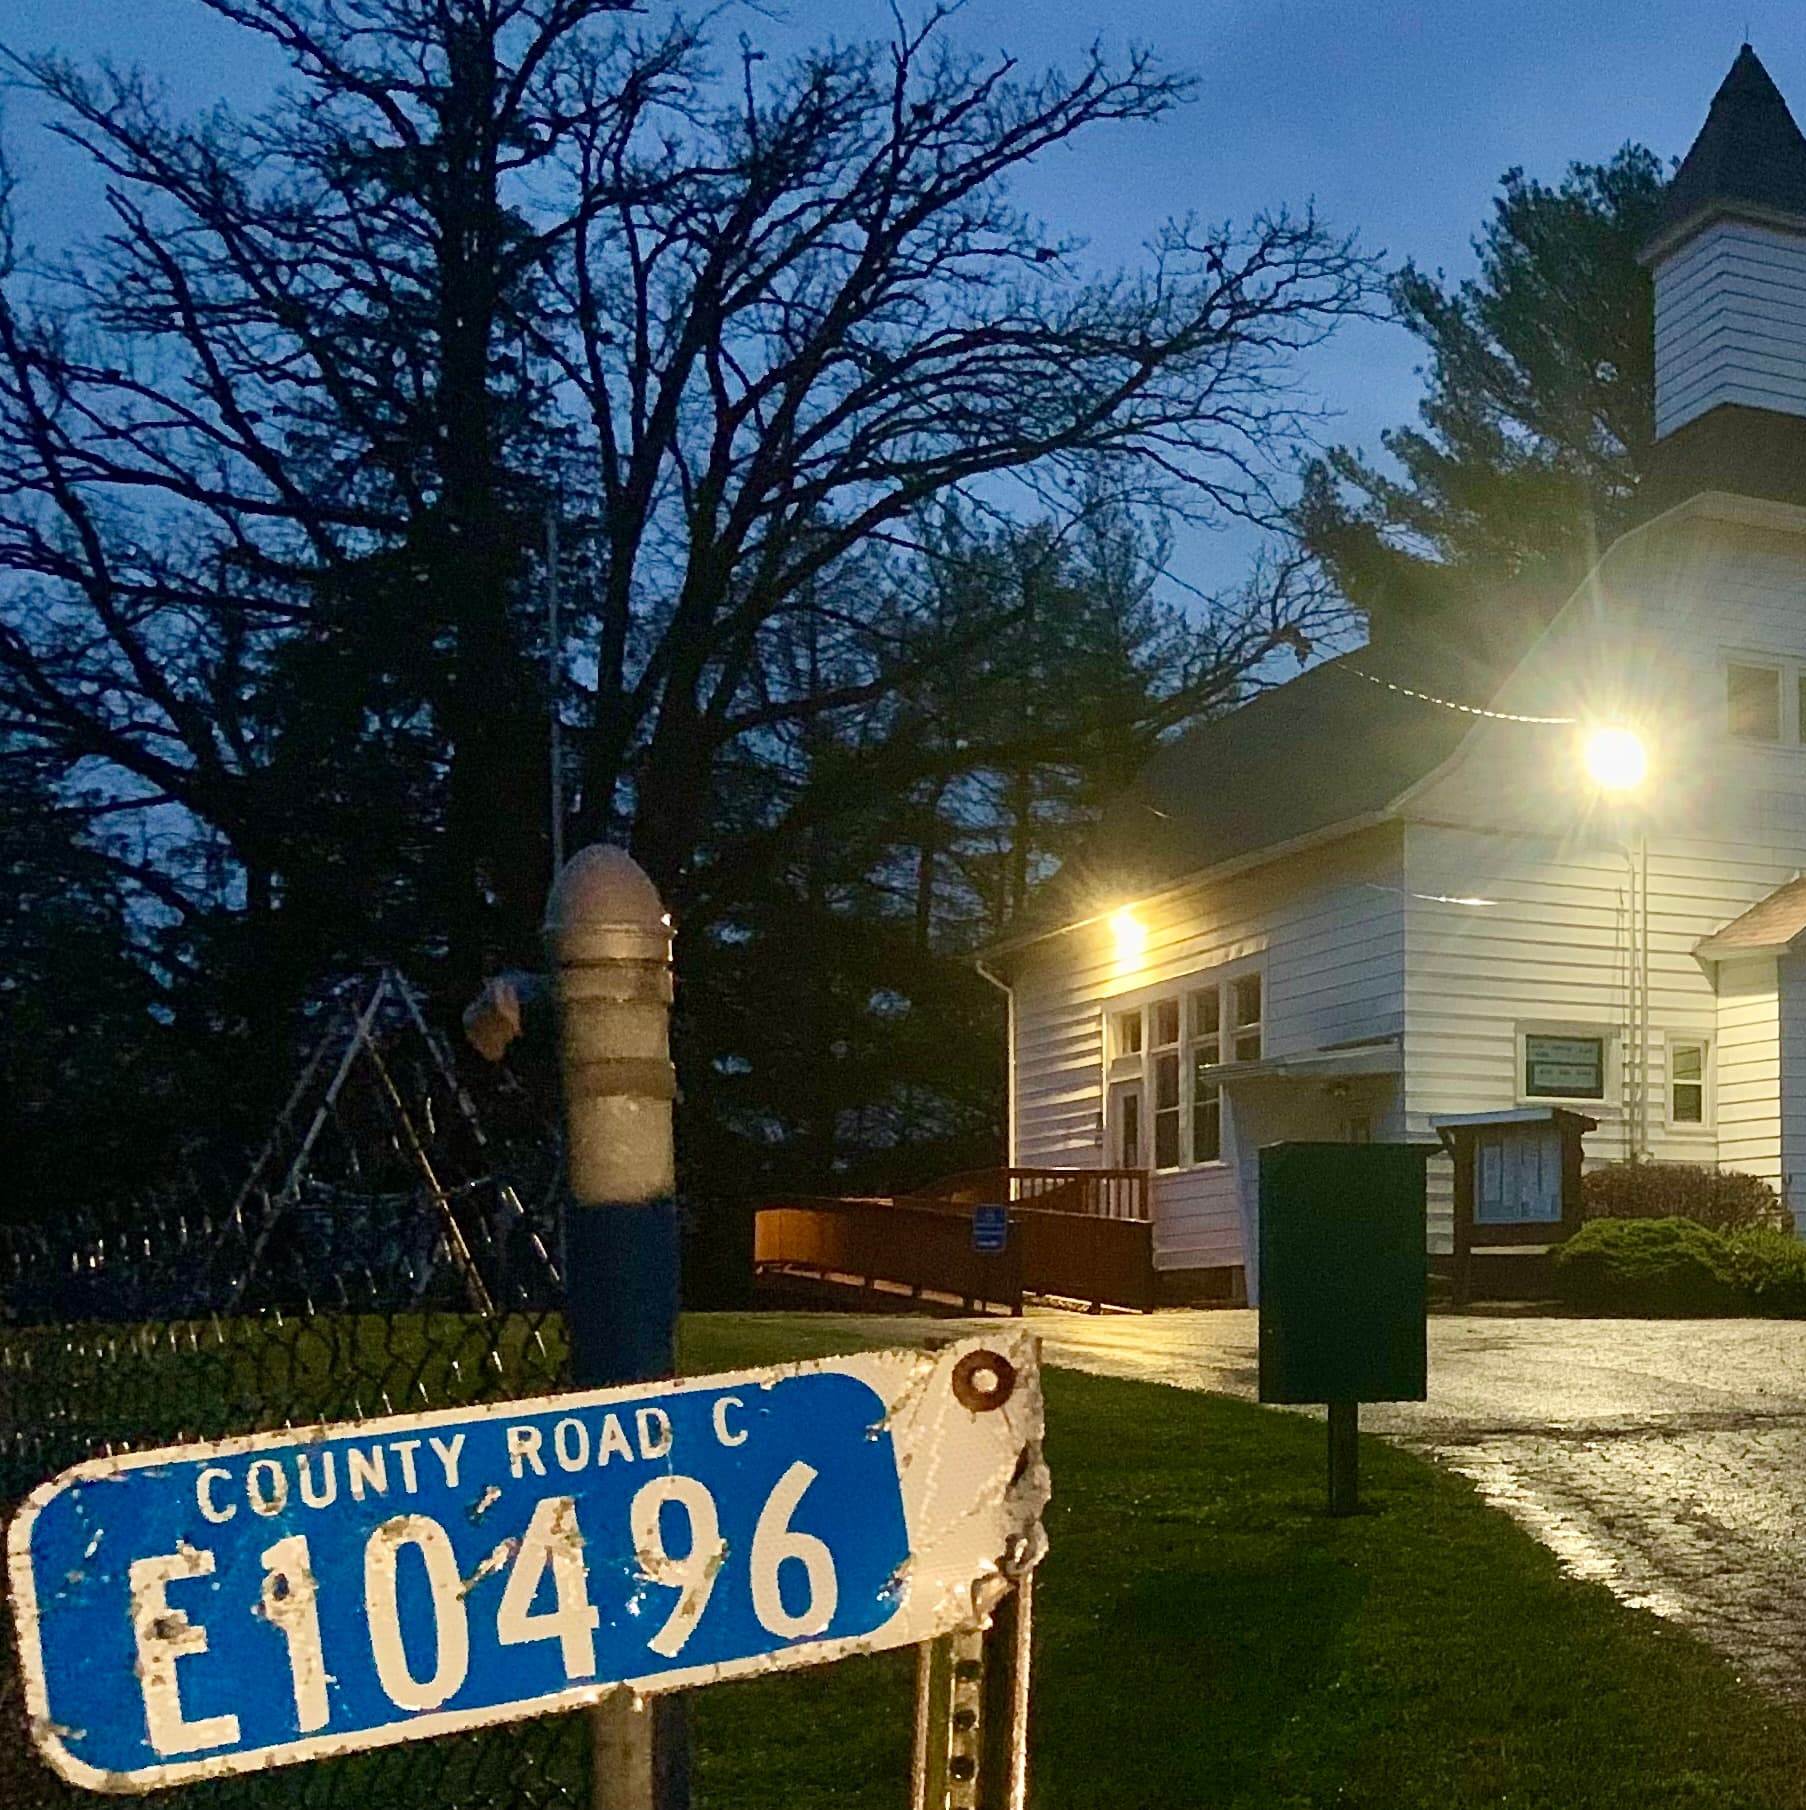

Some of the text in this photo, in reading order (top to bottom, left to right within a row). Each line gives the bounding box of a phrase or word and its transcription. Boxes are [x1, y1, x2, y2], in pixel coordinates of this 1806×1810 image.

[197, 1396, 750, 1525] COUNTY ROAD C
[129, 1460, 840, 1756] E10496
